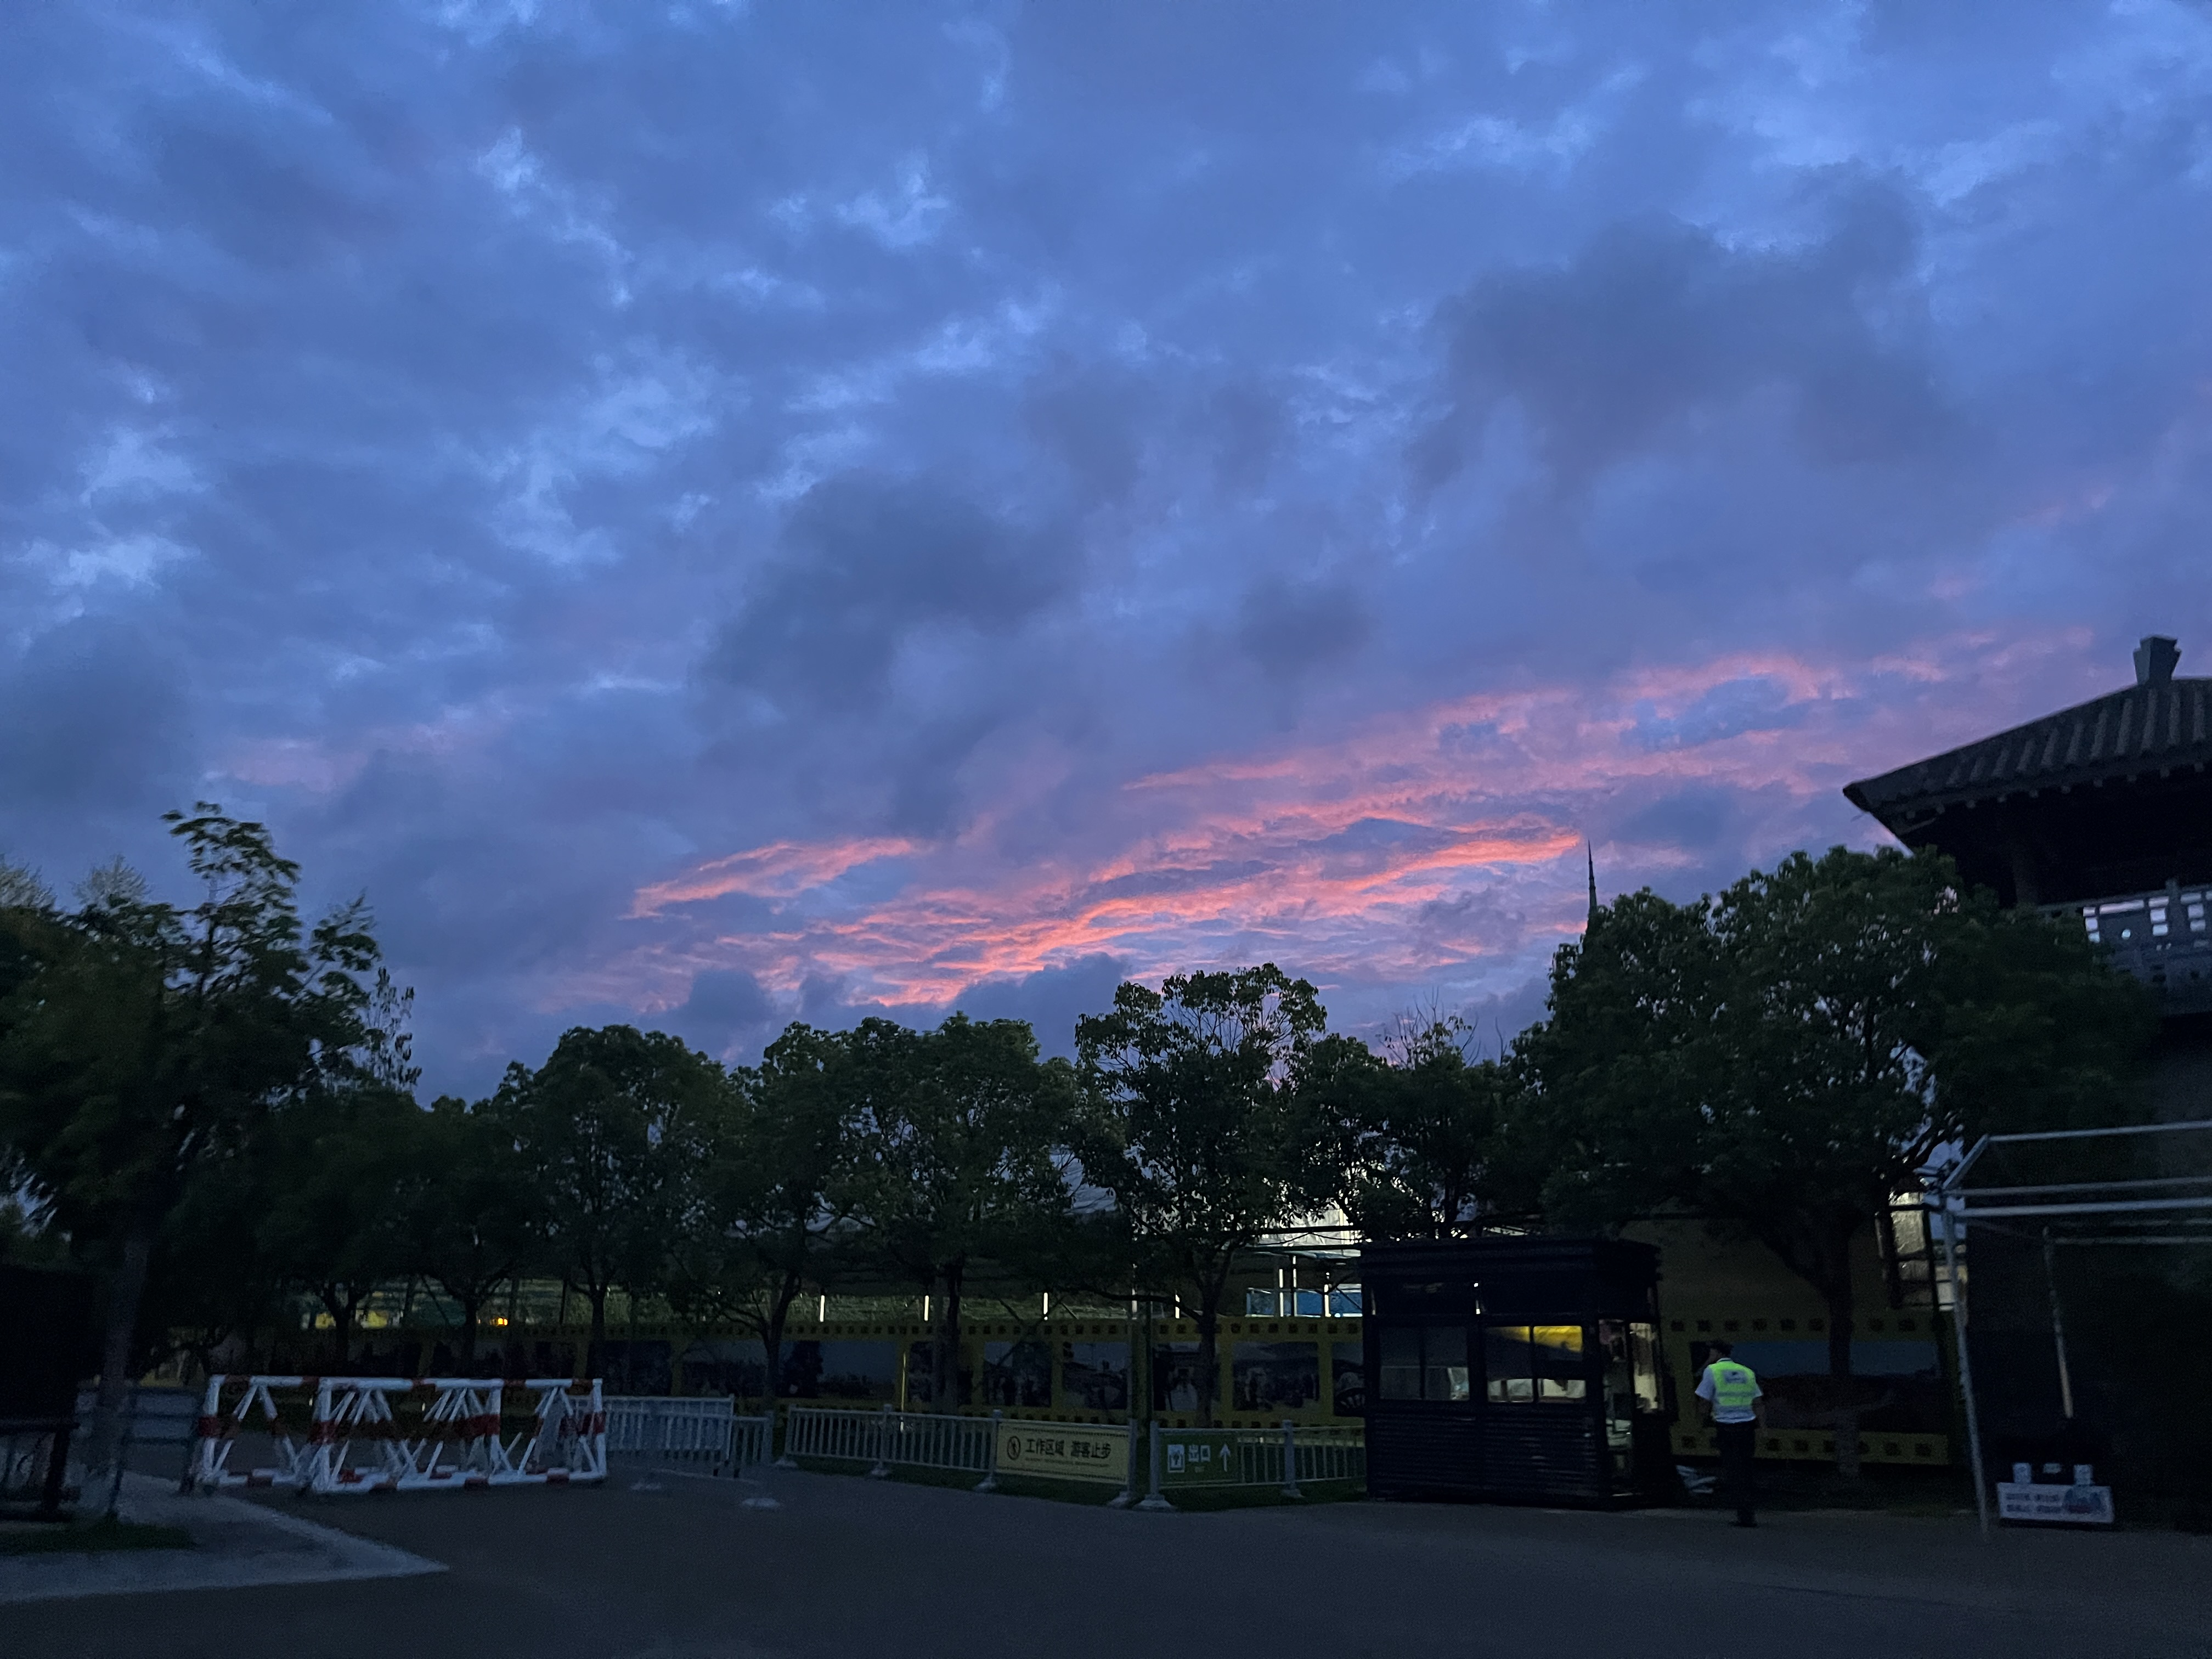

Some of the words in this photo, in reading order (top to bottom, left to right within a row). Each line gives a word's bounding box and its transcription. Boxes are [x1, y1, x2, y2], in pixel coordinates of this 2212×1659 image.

[1025, 1438, 1064, 1457] 工作区域
[1071, 1440, 1111, 1459] 游客止步
[1188, 1444, 1211, 1462] 出口
